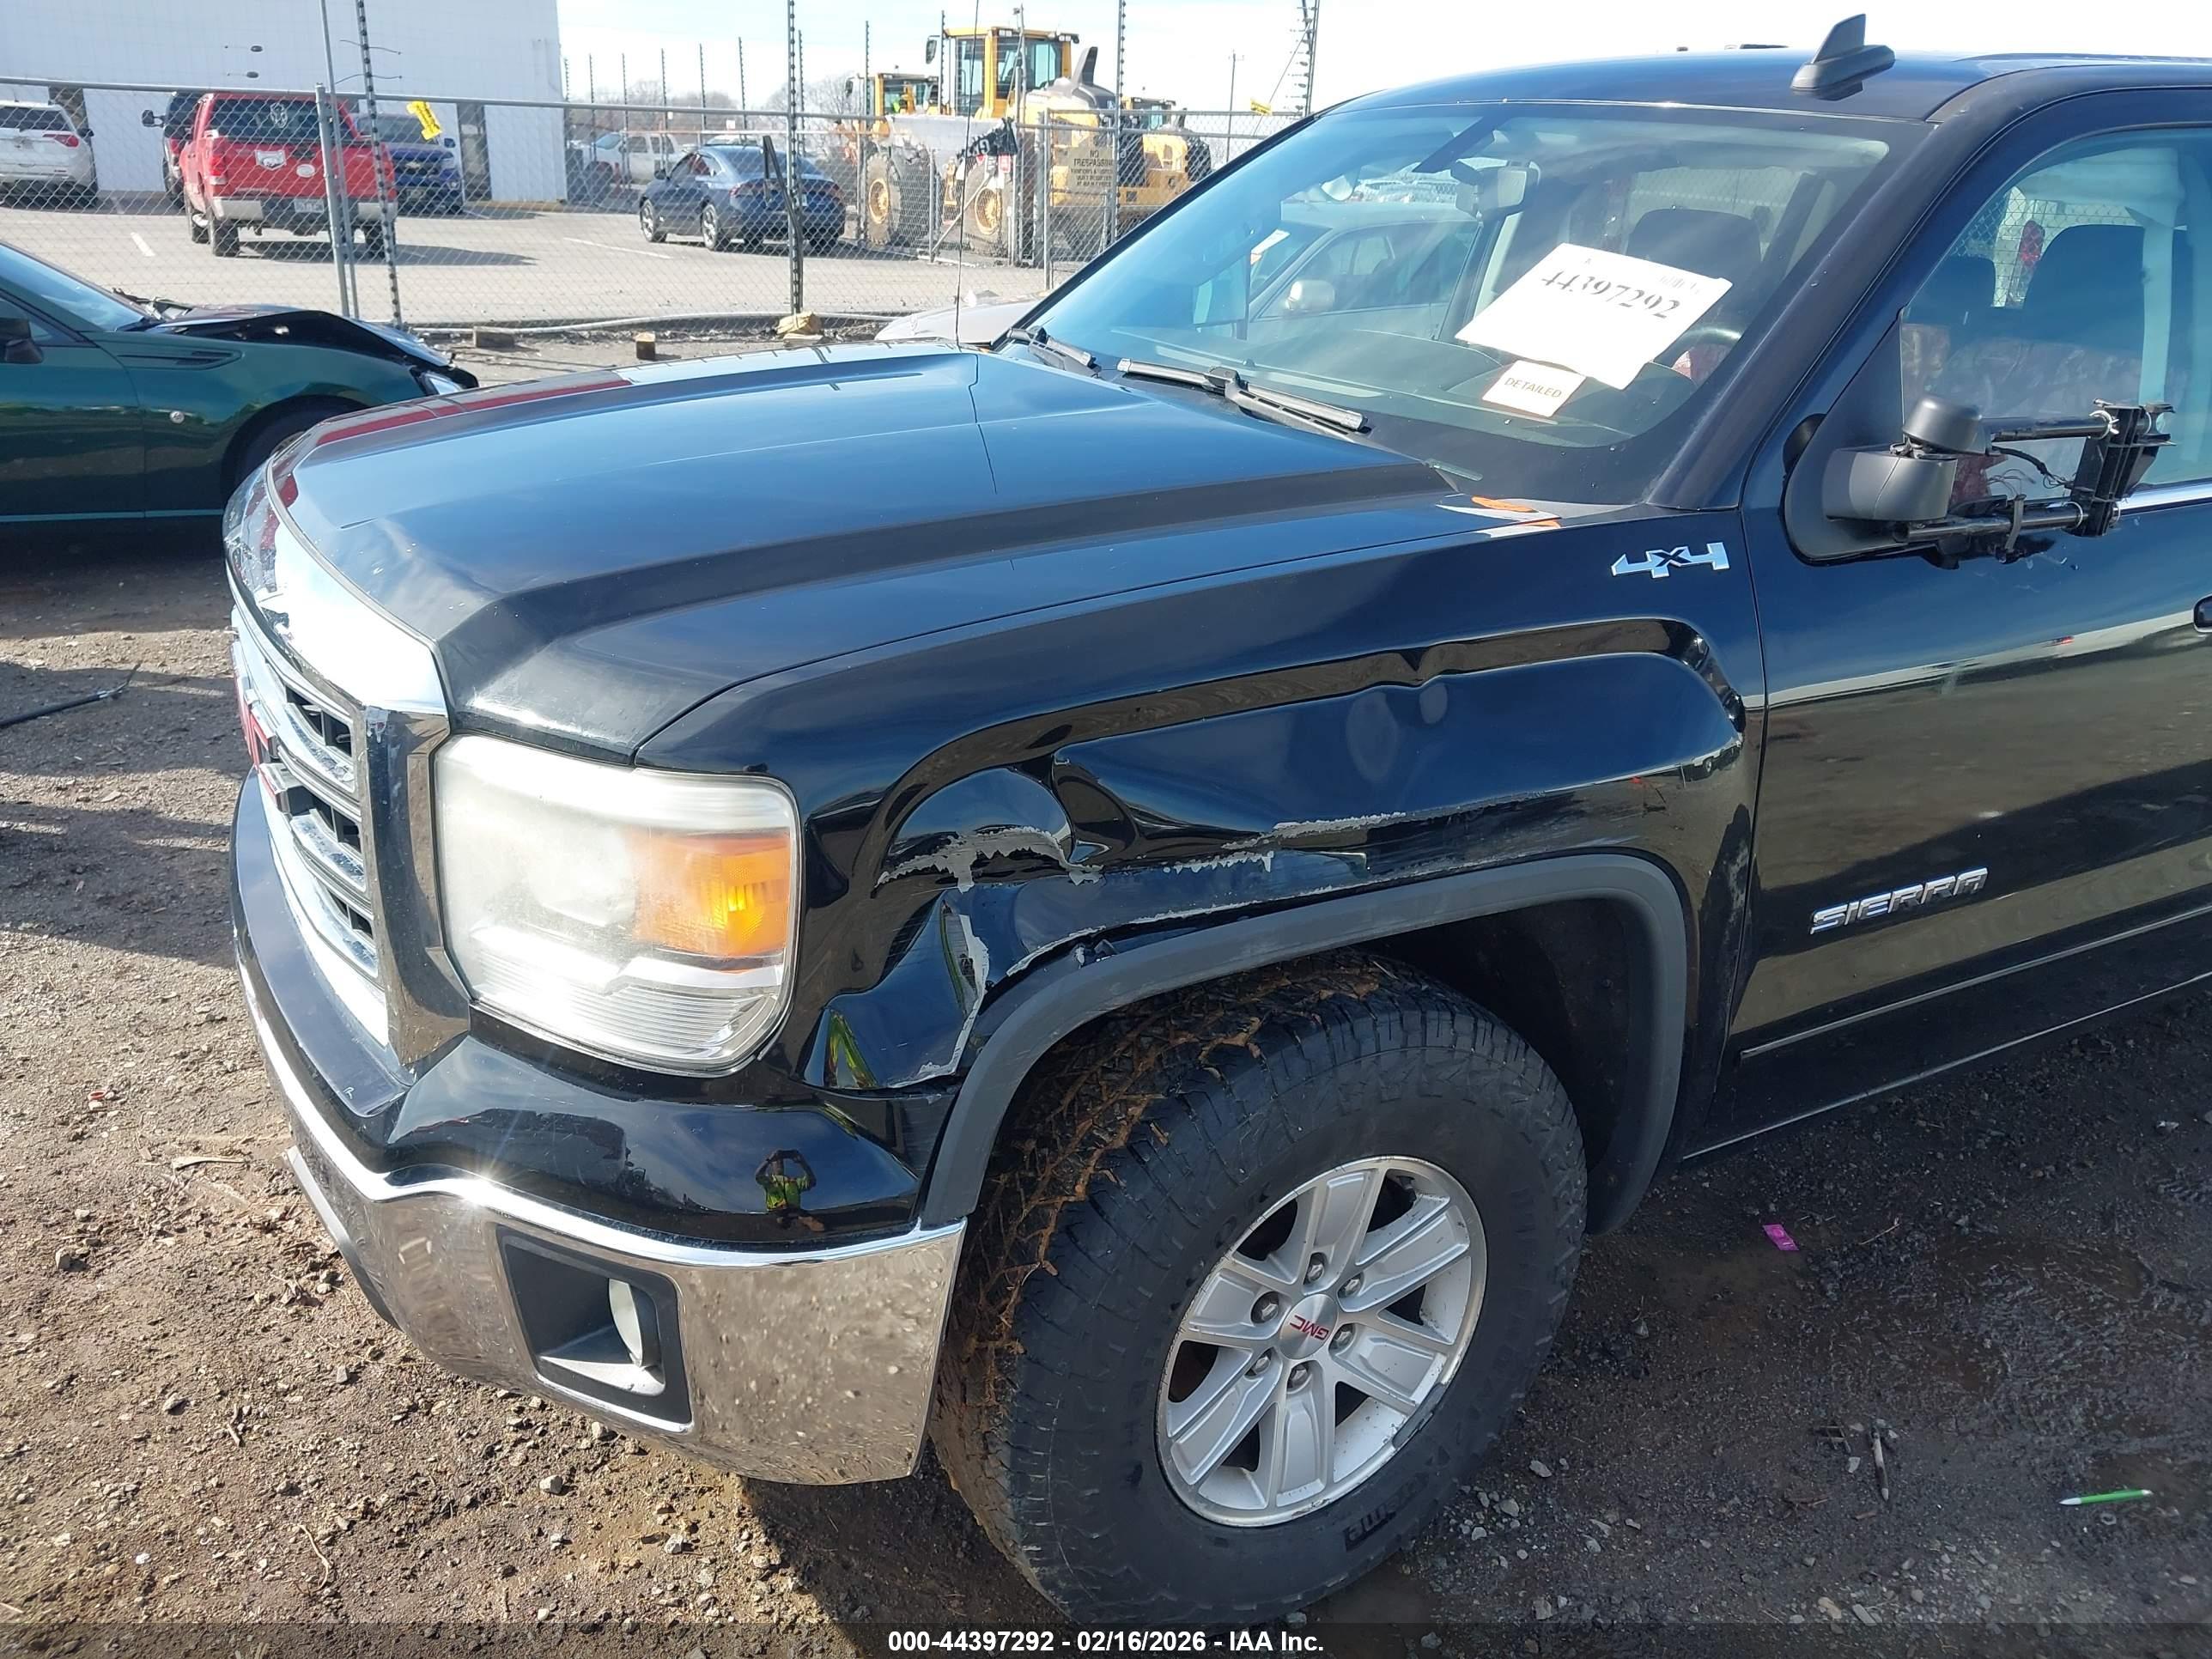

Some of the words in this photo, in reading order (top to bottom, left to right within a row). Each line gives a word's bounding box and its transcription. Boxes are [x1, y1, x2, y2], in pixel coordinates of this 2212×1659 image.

[1073, 158, 1113, 167] TRESPASSIN
[1090, 149, 1099, 158] NO
[1541, 270, 1680, 319] 44397292
[1504, 377, 1562, 398] DETAILED
[1809, 867, 1989, 935] SIERRA
[1289, 1315, 1329, 1341] GMC
